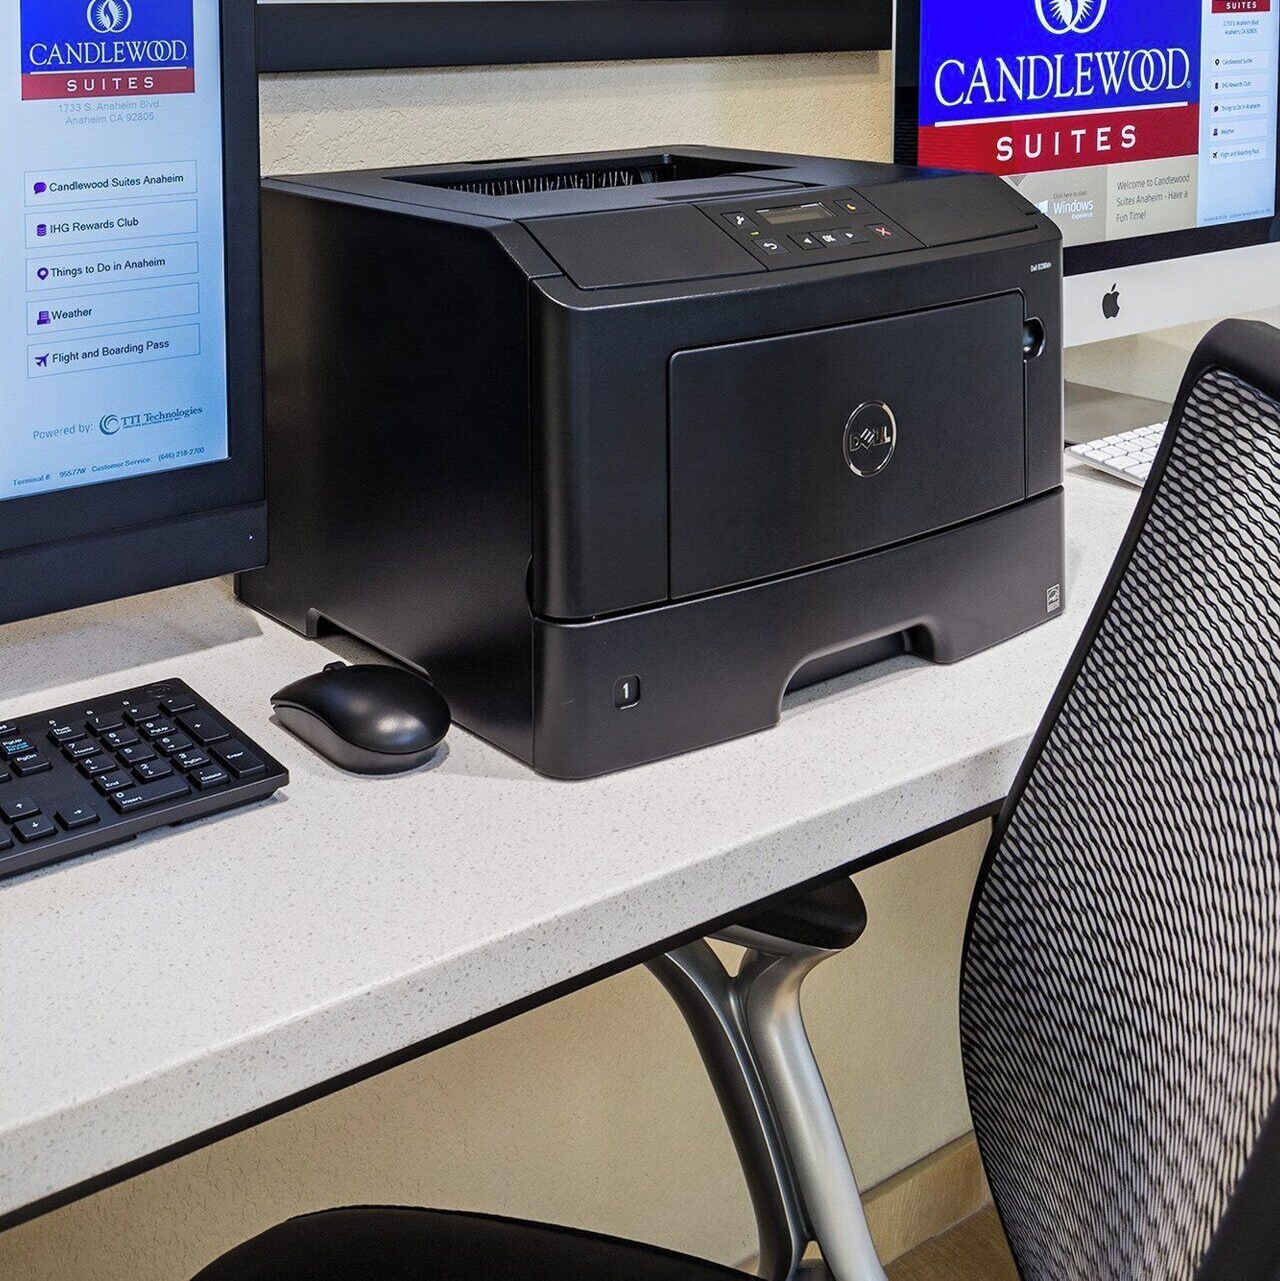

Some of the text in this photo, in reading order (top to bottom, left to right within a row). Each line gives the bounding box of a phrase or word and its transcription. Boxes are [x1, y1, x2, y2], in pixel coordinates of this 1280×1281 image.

[1226, 1, 1257, 10] SUITES
[29, 39, 187, 66] CANDLEWOOD
[66, 76, 154, 92] SUITES
[934, 47, 1191, 107] CANDLEWOOD
[58, 103, 82, 113] 1733
[97, 101, 137, 112] Anaheim
[65, 112, 155, 125] Anaheim CA 92805
[996, 124, 1137, 162] SUITES
[49, 173, 184, 193] Candlewood Suites Anaheim
[1116, 173, 1190, 191] Welcome to Candlewood
[1053, 199, 1094, 215] Windows
[1116, 194, 1136, 207] Suites
[1136, 190, 1163, 204] Anaheim
[1168, 189, 1183, 200] Have
[1184, 191, 1188, 199] a
[1116, 209, 1147, 223] Fun Time!
[50, 217, 139, 234] IHG Rewards Club
[50, 257, 166, 278] Things to Do in Anaheim
[51, 307, 92, 320] Weather
[52, 340, 170, 365] Flight and Boarding Pass
[33, 425, 76, 439] Powered
[78, 422, 94, 434] by:
[121, 414, 141, 426] TTI
[143, 406, 203, 422] Technologies
[850, 425, 891, 452] DELL
[13, 475, 44, 486] Terminal
[91, 462, 124, 472] Customer
[622, 682, 629, 699] 1
[226, 751, 244, 760] Enter
